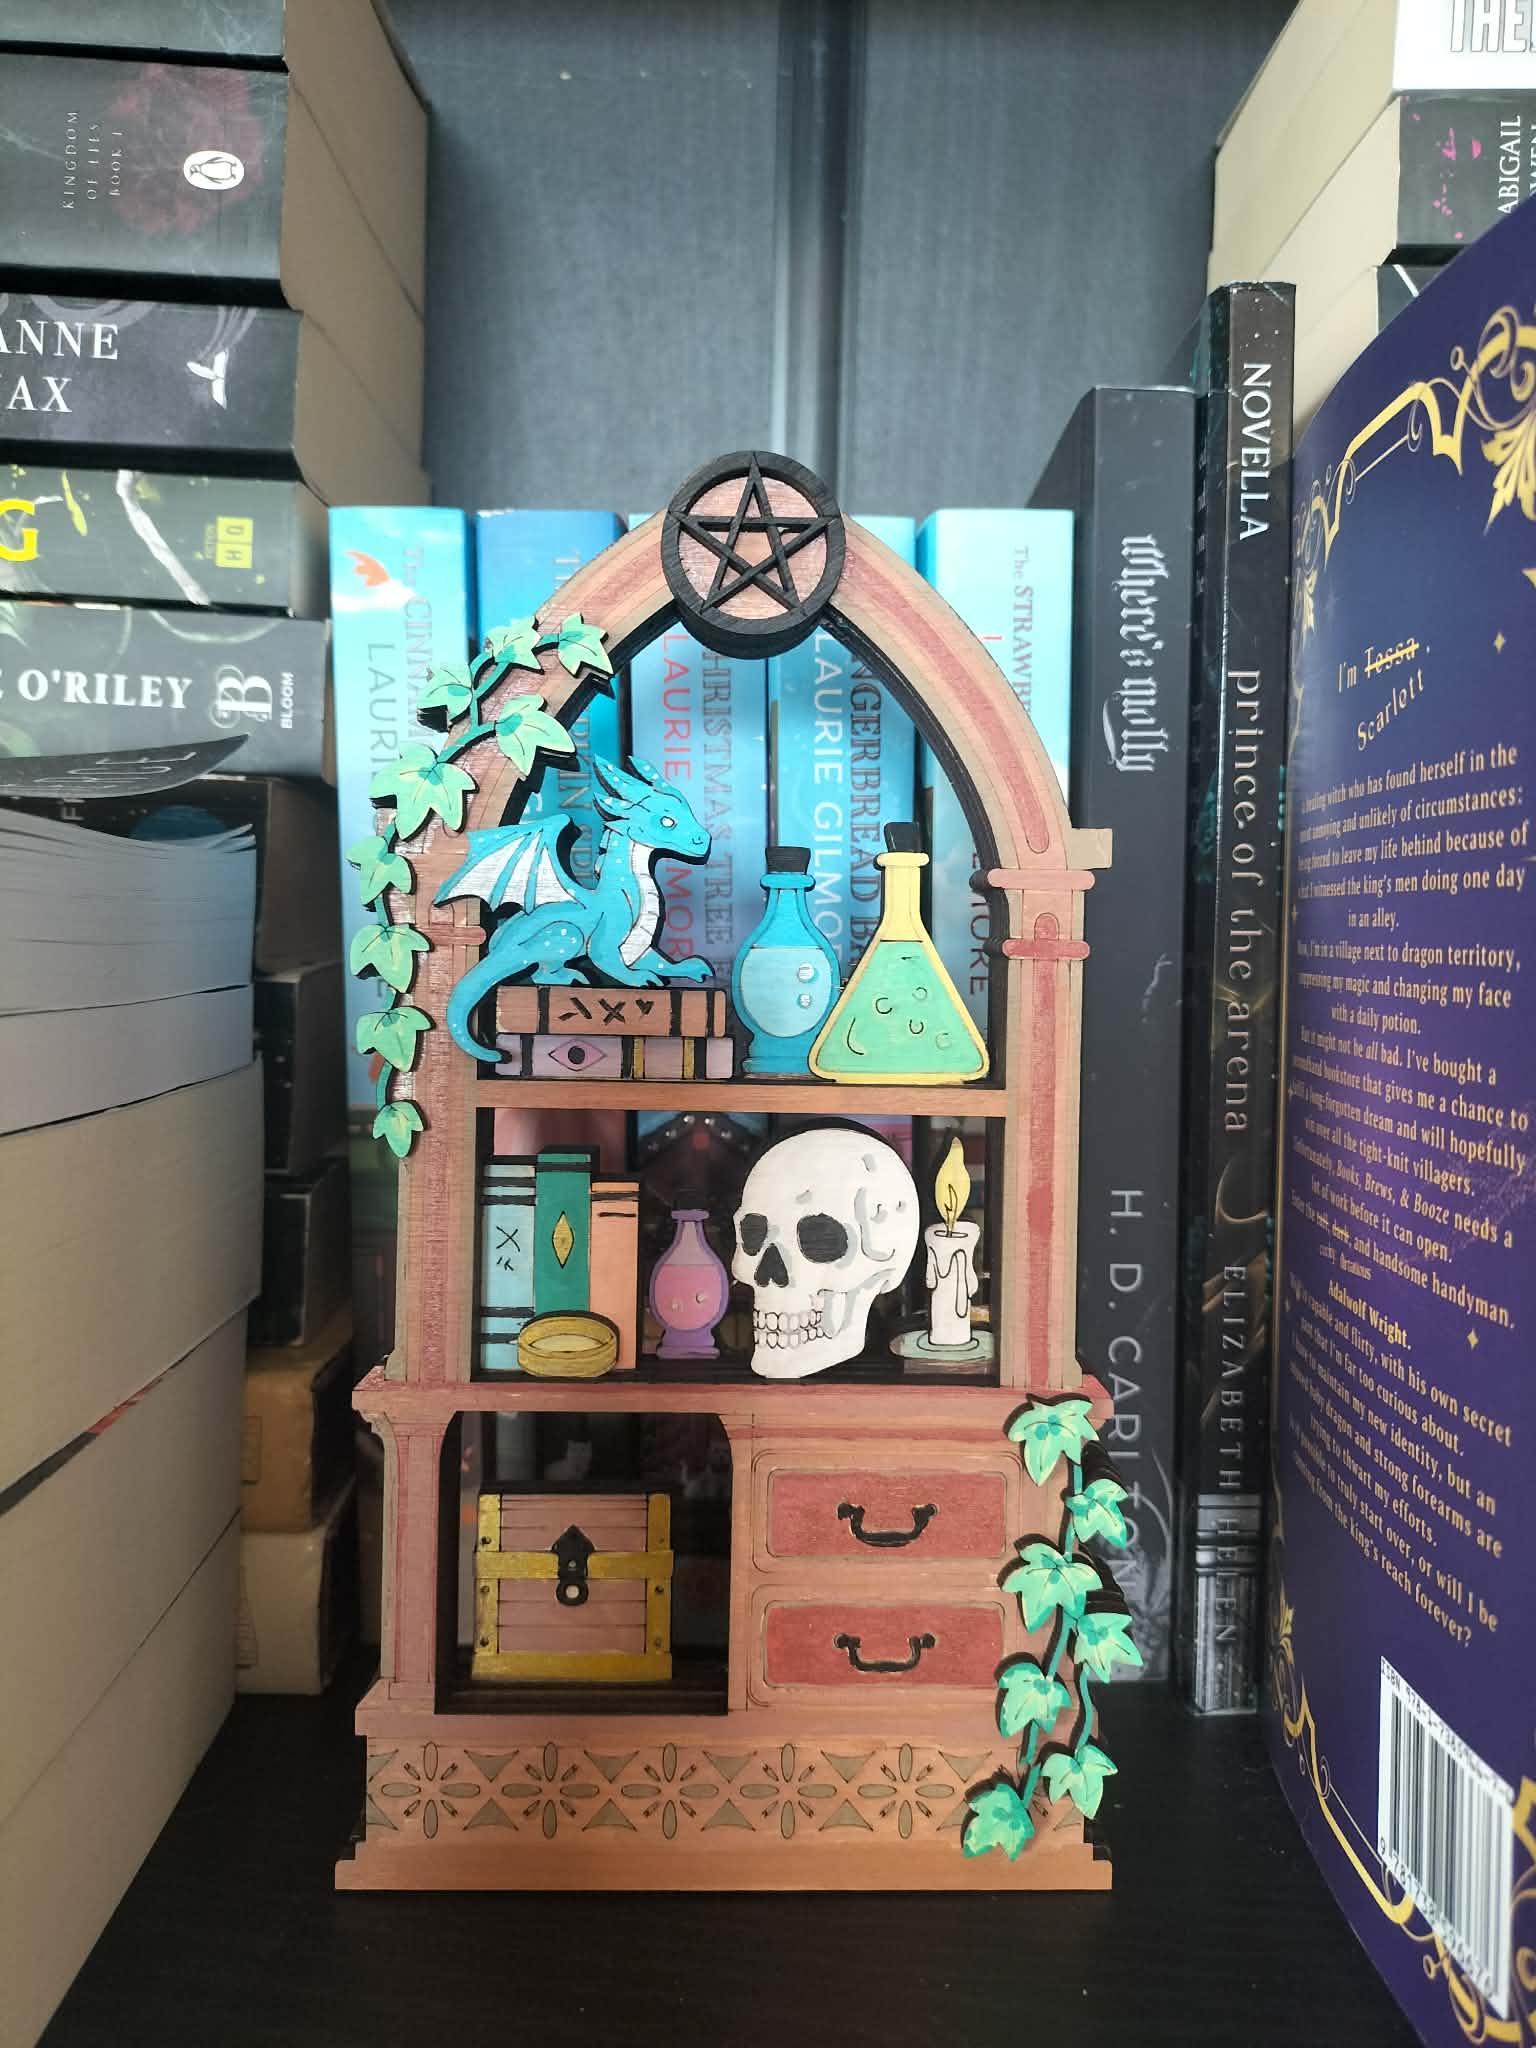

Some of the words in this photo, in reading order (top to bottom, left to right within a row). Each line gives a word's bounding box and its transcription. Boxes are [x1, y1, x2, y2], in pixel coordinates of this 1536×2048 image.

[62, 111, 79, 210] KINGDOM
[1496, 115, 1521, 214] ABIGAIL
[1238, 362, 1273, 541] NOVELLA
[17, 669, 193, 709] O'RILEY
[280, 672, 294, 729] BLOOM
[662, 634, 692, 782] LAURIE
[814, 634, 843, 785] LAURIE
[1338, 661, 1358, 692] I'm
[1356, 667, 1425, 751] Scarlett
[1227, 668, 1265, 830] prince
[1367, 775, 1383, 795] has
[1385, 763, 1416, 791] found
[1420, 751, 1465, 784] herself
[1470, 748, 1485, 772] in
[1490, 742, 1518, 770] the
[1341, 845, 1362, 865] leave
[1364, 844, 1379, 865] my
[1380, 838, 1399, 861] life
[1401, 832, 1442, 858] behind
[1445, 828, 1505, 853] because
[1510, 818, 1530, 847] of
[1342, 811, 1357, 833] and
[1359, 803, 1398, 829] unlikely
[1400, 798, 1412, 823] of
[1415, 785, 1524, 821] circumstances:
[703, 852, 734, 945] TREE
[1231, 842, 1265, 888] of
[1347, 876, 1361, 896] the
[1363, 874, 1392, 899] king's
[1394, 871, 1418, 893] men
[1421, 869, 1459, 895] doing
[1462, 868, 1490, 890] one
[1495, 862, 1526, 893] day
[1228, 908, 1263, 982] the
[1348, 908, 1357, 928] in
[1358, 911, 1369, 929] an
[1372, 906, 1400, 932] alley.
[1335, 940, 1362, 965] village
[1363, 943, 1384, 961] next
[1387, 944, 1399, 962] to
[1401, 941, 1443, 969] dragon
[1447, 942, 1522, 974] territory,
[1345, 974, 1370, 997] magic
[1372, 975, 1391, 996] and
[1393, 976, 1448, 1007] changing
[1451, 985, 1473, 1010] my
[1478, 980, 1512, 1009] face
[1331, 1001, 1348, 1022] with
[1356, 1004, 1379, 1032] daily
[1382, 1013, 1422, 1036] potion.
[1224, 1001, 1251, 1132] arena
[1323, 1059, 1361, 1089] bookstore
[1362, 1072, 1382, 1097] that
[1384, 1079, 1413, 1105] gives
[1416, 1090, 1436, 1112] me
[1438, 1095, 1447, 1113] a
[1450, 1094, 1504, 1128] chance
[1510, 1111, 1529, 1133] to
[1337, 1038, 1351, 1055] not
[1353, 1036, 1364, 1058] be
[1365, 1040, 1379, 1062] all
[1381, 1045, 1403, 1068] bad.
[1406, 1047, 1429, 1073] I've
[1433, 1051, 1482, 1086] bought
[1488, 1066, 1497, 1086] a
[1331, 1127, 1342, 1146] all
[1343, 1131, 1357, 1153] the
[1359, 1138, 1409, 1174] tight-knit
[1412, 1155, 1475, 1197] villagers.
[1363, 1105, 1394, 1133] dream
[1396, 1117, 1418, 1142] and
[1420, 1125, 1445, 1151] will
[1449, 1129, 1527, 1176] hopefully
[1108, 1190, 1145, 1236] H.
[1349, 1196, 1379, 1229] before
[1381, 1211, 1391, 1236] it
[1393, 1223, 1413, 1247] can
[1416, 1233, 1453, 1264] open.
[1364, 1171, 1396, 1206] Brews,
[1400, 1186, 1409, 1209] &
[1413, 1191, 1450, 1226] Booze
[1453, 1211, 1498, 1244] needs
[1503, 1230, 1513, 1249] a
[1107, 1263, 1144, 1309] D.
[1328, 1279, 1367, 1321] Adalwolf
[1368, 1304, 1412, 1351] Wright.
[1353, 1236, 1371, 1258] and
[1372, 1244, 1429, 1289] handsome
[1432, 1270, 1516, 1330] handyman.
[1218, 1265, 1248, 1489] ELIZABETH
[1334, 1317, 1350, 1340] and
[1351, 1325, 1379, 1366] flirty,
[1381, 1351, 1405, 1381] with
[1407, 1365, 1428, 1397] his
[1430, 1386, 1459, 1417] own
[1463, 1404, 1512, 1448] secret
[1344, 1352, 1358, 1377] far
[1358, 1367, 1375, 1392] too
[1376, 1381, 1418, 1426] curious
[1421, 1413, 1465, 1458] about.
[1352, 1395, 1366, 1420] my
[1367, 1408, 1388, 1437] new
[1390, 1423, 1444, 1483] identity,
[1447, 1463, 1473, 1500] but
[1476, 1487, 1497, 1517] an
[1342, 1448, 1372, 1490] thwart
[1374, 1480, 1390, 1509] my
[1391, 1499, 1439, 1548] efforts.
[1353, 1430, 1372, 1457] and
[1373, 1444, 1410, 1488] strong
[1411, 1474, 1472, 1538] forearms
[1476, 1526, 1503, 1559] are
[1215, 1518, 1240, 1642] HELEN
[1337, 1474, 1359, 1511] truly
[1359, 1500, 1384, 1535] start
[1386, 1525, 1416, 1567] over,
[1418, 1554, 1432, 1578] or
[1436, 1567, 1462, 1606] will
[1478, 1599, 1498, 1633] be
[1349, 1521, 1380, 1563] king's
[1381, 1551, 1412, 1596] reach
[1414, 1583, 1473, 1649] forever?
